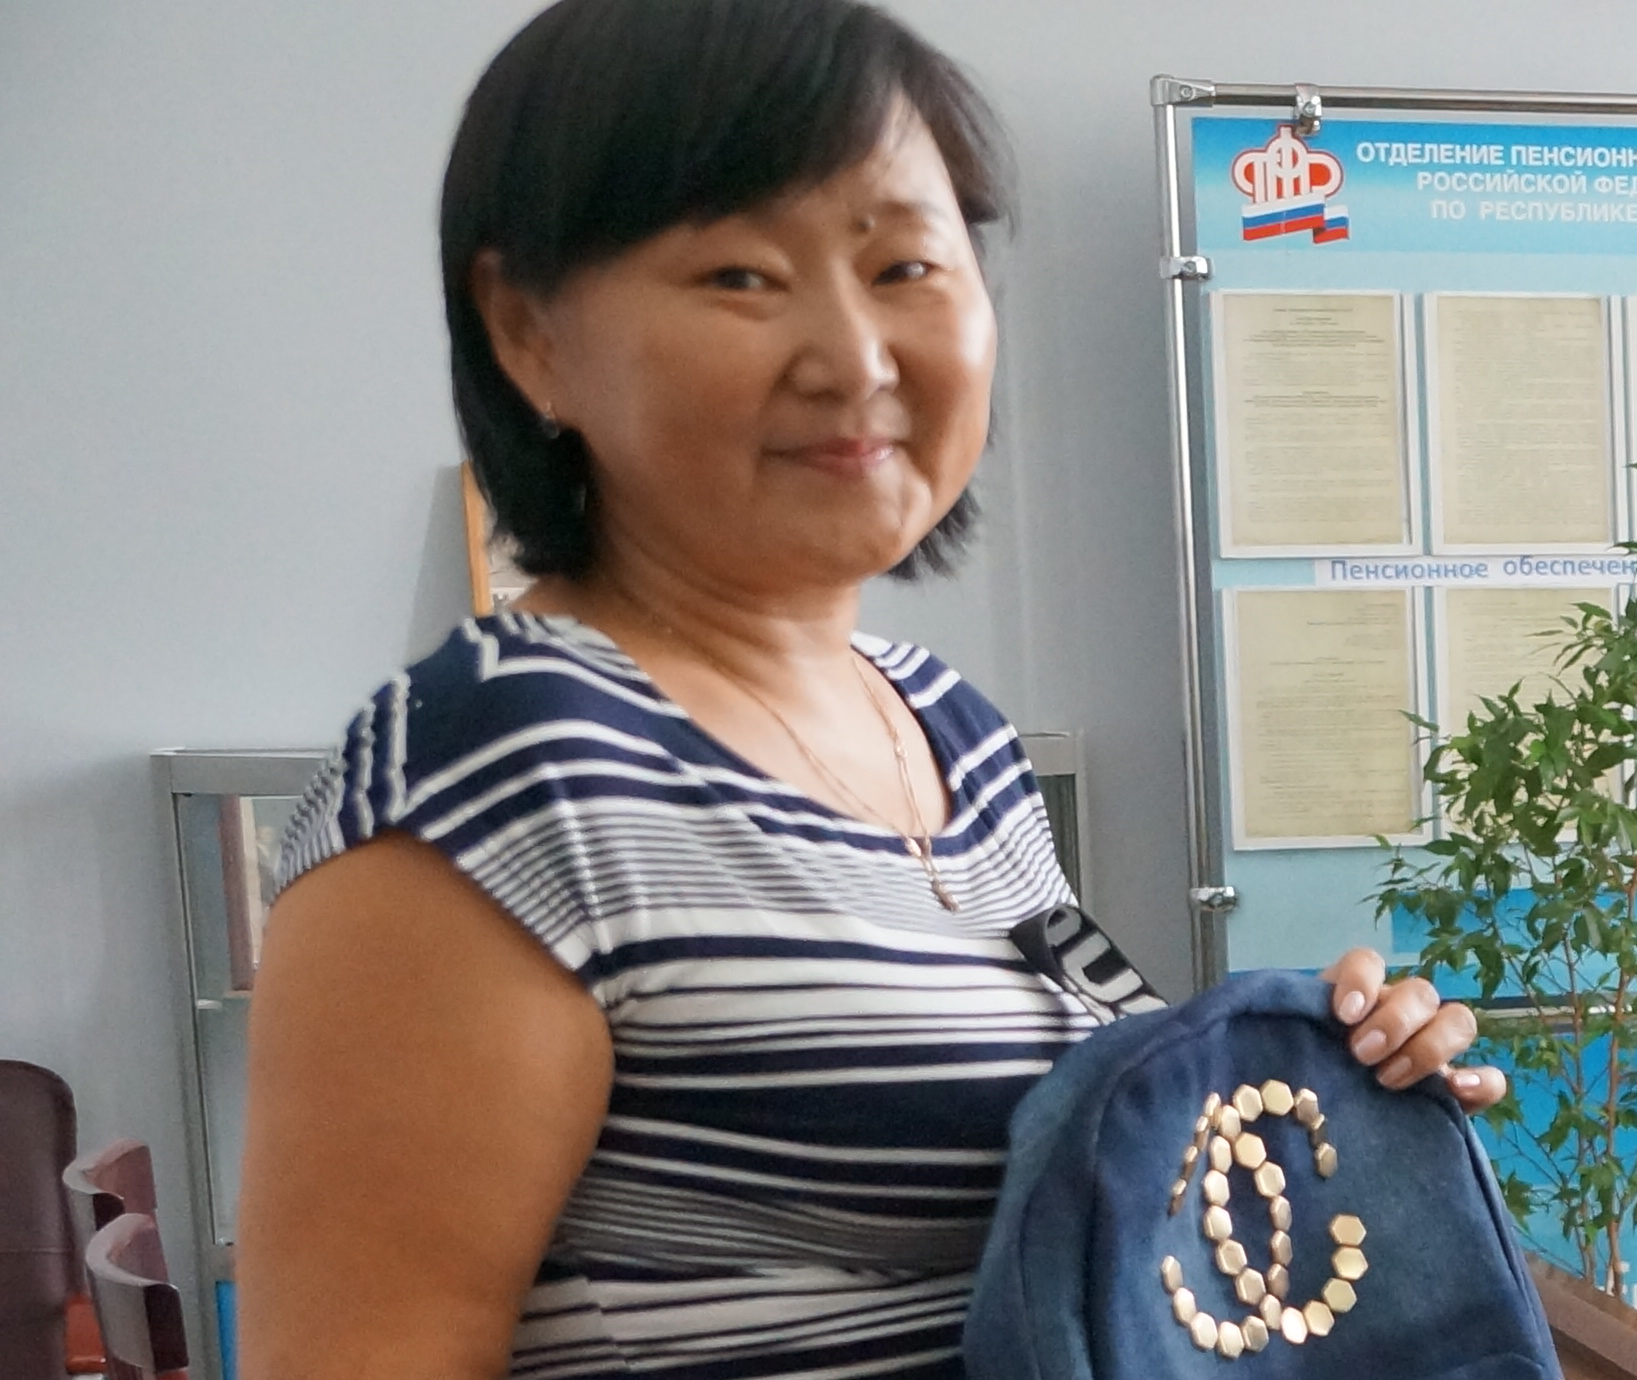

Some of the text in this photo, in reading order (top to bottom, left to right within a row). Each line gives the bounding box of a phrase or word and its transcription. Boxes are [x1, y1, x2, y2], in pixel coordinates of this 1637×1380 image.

[1356, 142, 1505, 167] ОТДЕЛЕНИЕ
[1416, 169, 1588, 194] РОССИЙСКОЙ
[1431, 200, 1466, 220] ПО
[1330, 560, 1489, 581] Пенсионное
